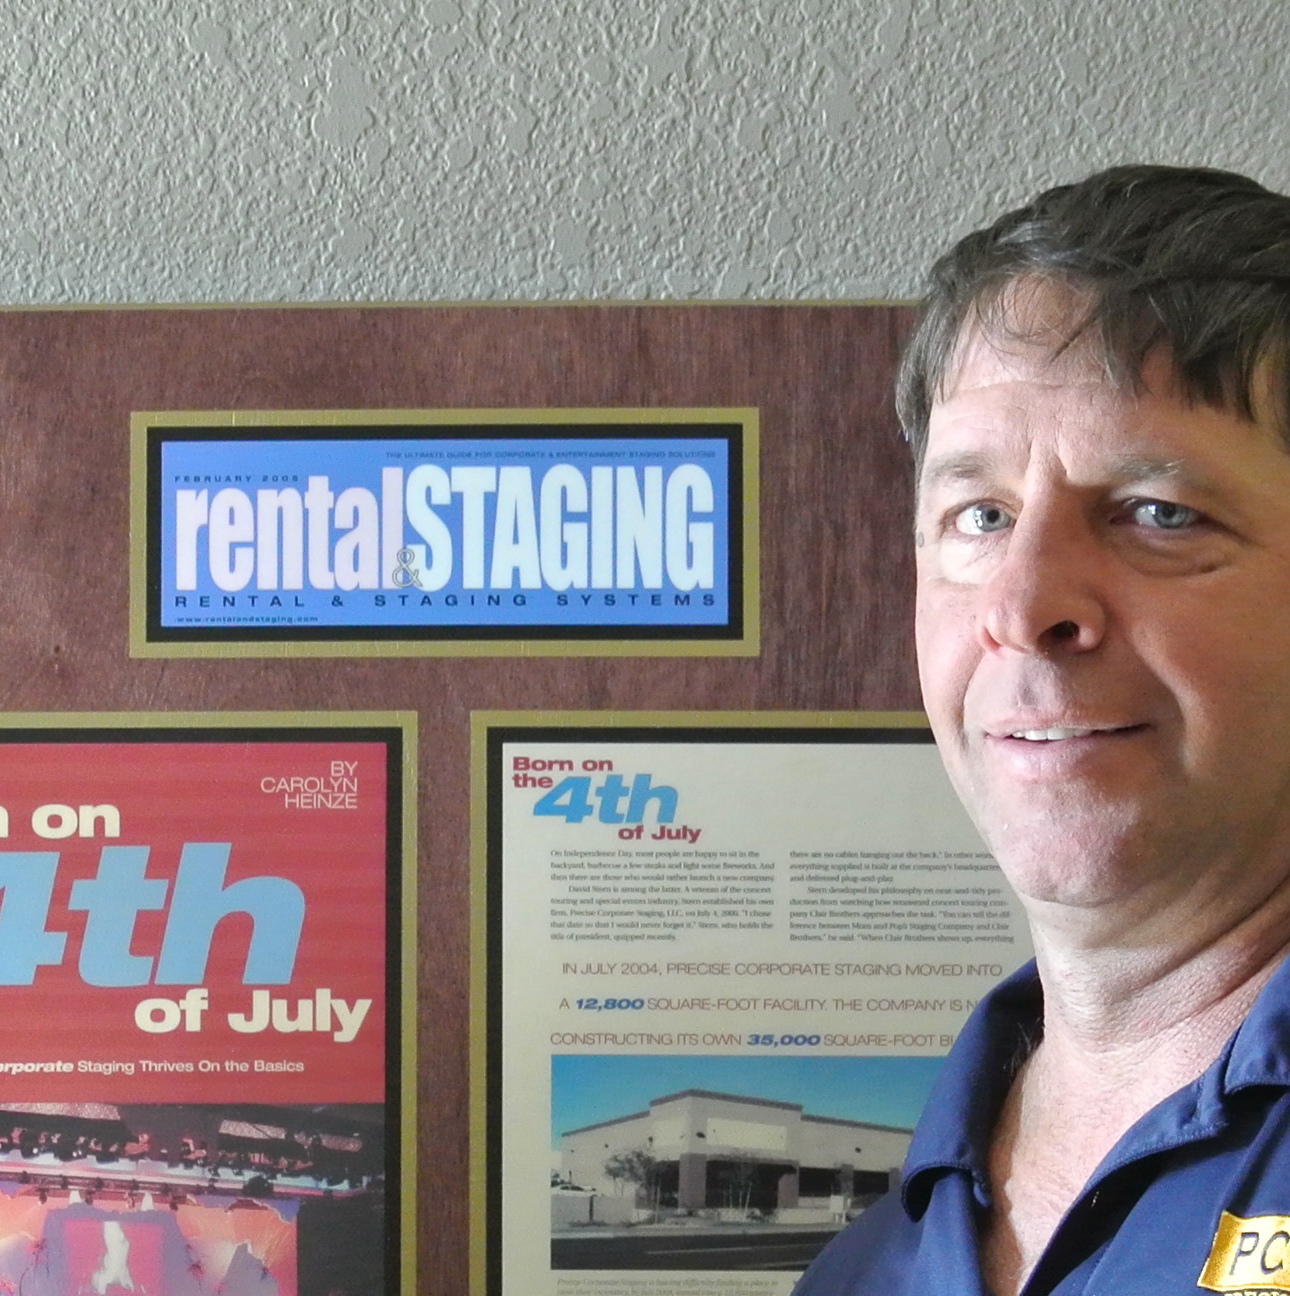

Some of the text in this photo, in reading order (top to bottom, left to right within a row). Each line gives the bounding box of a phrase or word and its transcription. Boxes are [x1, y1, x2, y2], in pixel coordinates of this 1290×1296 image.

[174, 475, 252, 483] FEBRUARY
[176, 463, 714, 591] rental & STAGING
[174, 594, 715, 607] RENTAL & STAGING SYSTEMS
[331, 761, 358, 776] BY
[512, 756, 613, 772] Born on
[261, 777, 358, 793] CAROLYN
[285, 793, 358, 809] HEINZE
[512, 773, 678, 824] the 4th
[31, 804, 121, 839] on
[618, 825, 701, 843] of July
[562, 963, 1003, 978] IN JULY 2004, PRECISE CORPORATE STAGING MOVED INTO
[559, 999, 570, 1011] A
[575, 998, 644, 1012] 12,800
[647, 999, 760, 1011] SQUARE-FOOT
[764, 999, 827, 1011] FACILITY.
[832, 999, 862, 1011] THE
[865, 999, 946, 1011] COMPANY
[950, 999, 963, 1011] IS
[134, 989, 372, 1043] of July
[550, 1033, 673, 1046] CONSTRUCTING
[676, 1033, 699, 1046] ITS
[702, 1033, 742, 1046] OWN
[746, 1033, 821, 1048] 35,000
[824, 1033, 937, 1046] SQUARE-FOOT
[77, 1060, 135, 1075] Staging
[140, 1060, 194, 1072] Thrives
[198, 1060, 220, 1072] On
[225, 1060, 250, 1072] the
[254, 1060, 305, 1072] Basics
